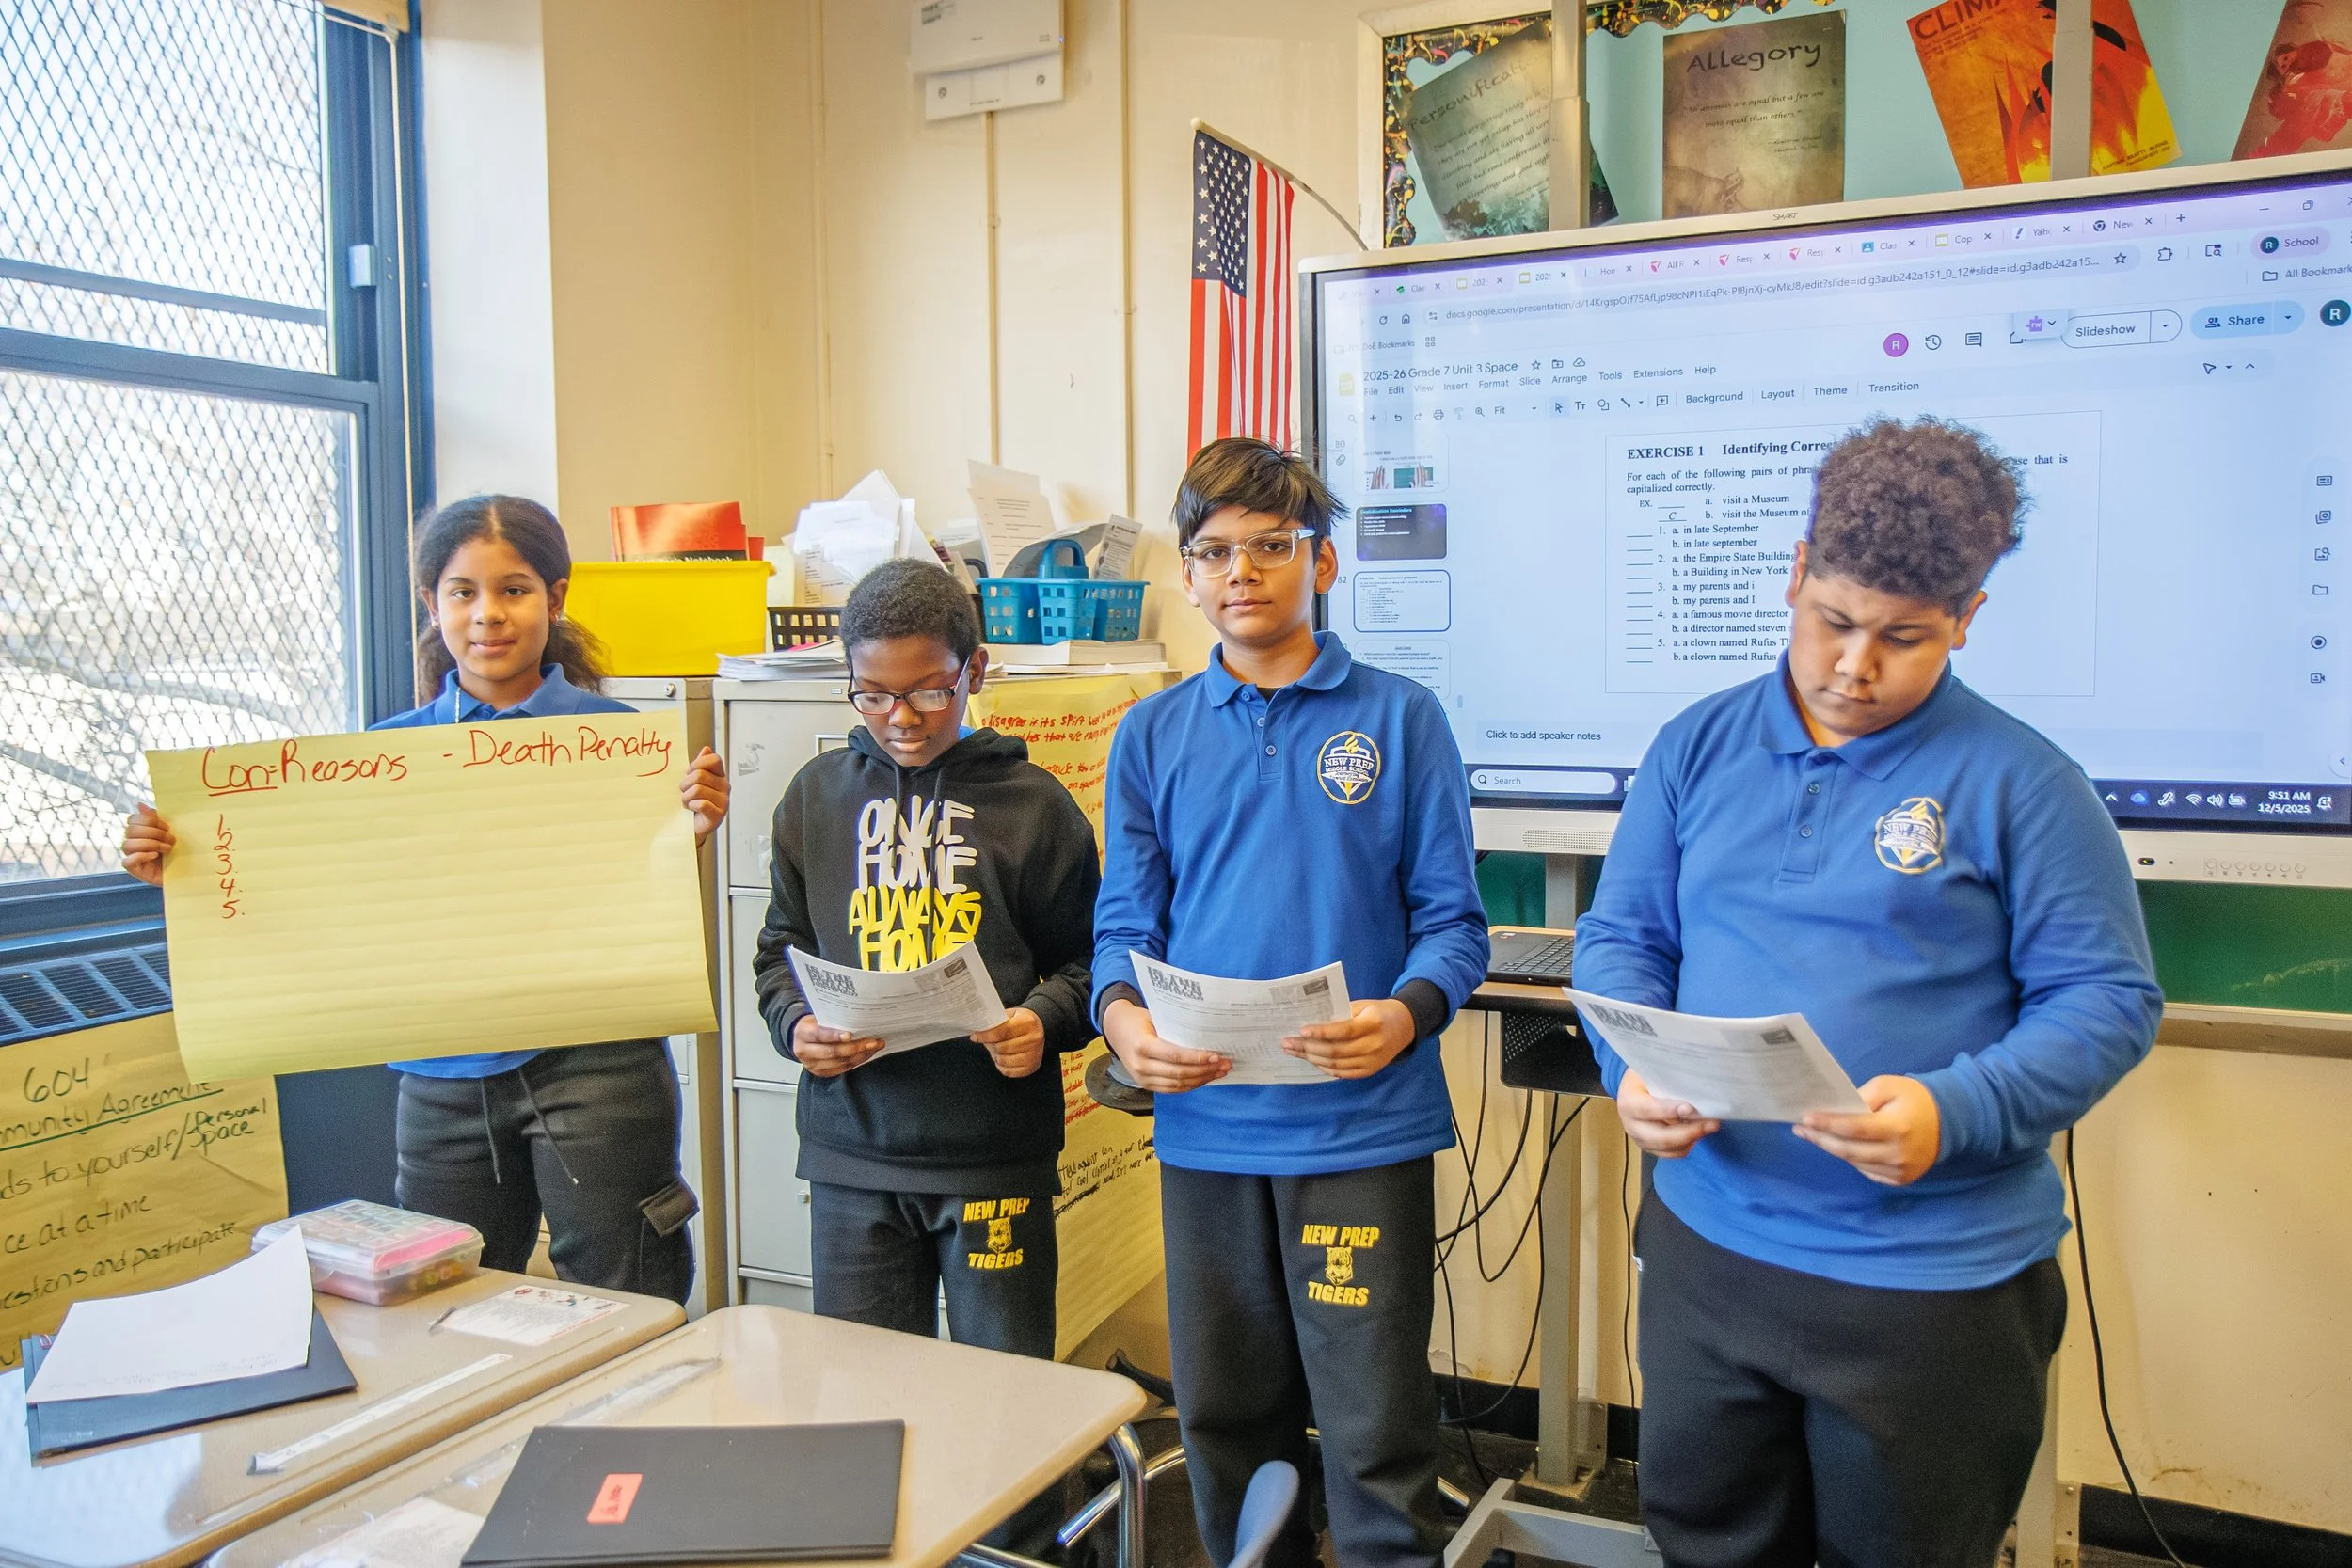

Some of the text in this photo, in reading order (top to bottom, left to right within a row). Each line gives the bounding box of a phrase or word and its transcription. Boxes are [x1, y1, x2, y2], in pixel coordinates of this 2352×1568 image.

[1915, 0, 2001, 39] CLIM
[1687, 44, 1821, 72] Allegory
[1749, 96, 1770, 107] equal
[1772, 94, 1786, 103] but
[1794, 92, 1808, 102] few
[1726, 115, 1748, 127] equal
[1772, 213, 1798, 221] SMART
[1955, 235, 1973, 245] Cop
[2284, 236, 2319, 247] School
[2284, 269, 2297, 278] All
[2075, 308, 2341, 337] Slideshow Share R
[1378, 340, 1415, 350] Bookmarks
[1891, 340, 1900, 350] R
[1364, 362, 1518, 381] 2025-26 Grade 7 Unit 3 Space
[1388, 386, 1404, 395] Edit
[1414, 384, 1434, 392] View
[1443, 382, 1468, 391] Insert
[1479, 379, 1509, 388] Format
[1519, 376, 1541, 387] Slide
[1552, 374, 1588, 385] Arrange
[1598, 372, 1623, 381] Tools
[1633, 367, 1683, 379] Extensions
[1694, 365, 1716, 375] Help
[1494, 382, 1919, 415] Fit Background Layout Theme Transition
[1628, 446, 1693, 459] EXERCISE
[1699, 446, 1704, 456] 1
[1722, 442, 1788, 457] Identifying
[1627, 472, 1642, 482] For
[1646, 470, 1666, 481] each
[1671, 470, 1682, 480] of
[1685, 469, 1698, 480] the
[1704, 467, 1746, 480] following
[1751, 467, 1772, 478] pairs
[1777, 466, 1788, 475] of
[2034, 455, 2053, 464] that
[2059, 454, 2068, 463] is
[1627, 483, 1715, 494] capitalized correctly.
[1722, 495, 1740, 504] visit
[1752, 494, 1789, 503] Museum
[1668, 508, 1798, 520] C b. visit the Museum
[1684, 523, 1759, 535] in late September
[1672, 538, 1757, 549] b. in late september
[1658, 555, 1666, 563] 2.
[1683, 553, 1697, 562] the
[1699, 553, 1731, 563] Empire
[1733, 552, 1756, 562] State
[1337, 576, 1347, 584] 82
[1672, 565, 1788, 578] b. Building in New York
[1658, 580, 1749, 593] 3. my parents and
[1672, 595, 1749, 607] b. my parents and
[1657, 610, 1788, 619] 4. famous movie director
[1672, 624, 1786, 633] b. director named steven
[1658, 639, 1666, 647] 5.
[1690, 638, 1717, 646] clown
[1719, 638, 1748, 646] named
[1751, 638, 1777, 646] Rufus
[1673, 651, 1777, 661] b. clown named Rufus
[1486, 730, 1601, 743] Click to add speaker notes
[281, 739, 407, 784] Reasons
[463, 729, 572, 768] Death
[578, 726, 672, 777] Penalty
[1324, 757, 1374, 770] NEW PREP
[1494, 776, 2311, 800] Search 9:51 AM
[2258, 803, 2312, 814] 12/5/2025
[214, 832, 235, 852] 2.
[216, 854, 238, 875] 3.
[858, 844, 977, 895] HOME
[220, 877, 243, 895] 4.
[221, 899, 245, 918] 5.
[850, 884, 981, 937] ALWAYS
[24, 1057, 90, 1103] 604
[194, 1098, 267, 1127] Personal
[190, 1119, 254, 1155] Space
[39, 1160, 70, 1188] to
[97, 1196, 151, 1223] time
[963, 1201, 994, 1222] NEW
[1301, 1224, 1380, 1247] NEW PREP
[92, 1253, 127, 1278] and
[131, 1223, 237, 1274] participate
[968, 1248, 1024, 1269] TIGERS
[1308, 1281, 1370, 1306] TIGERS
